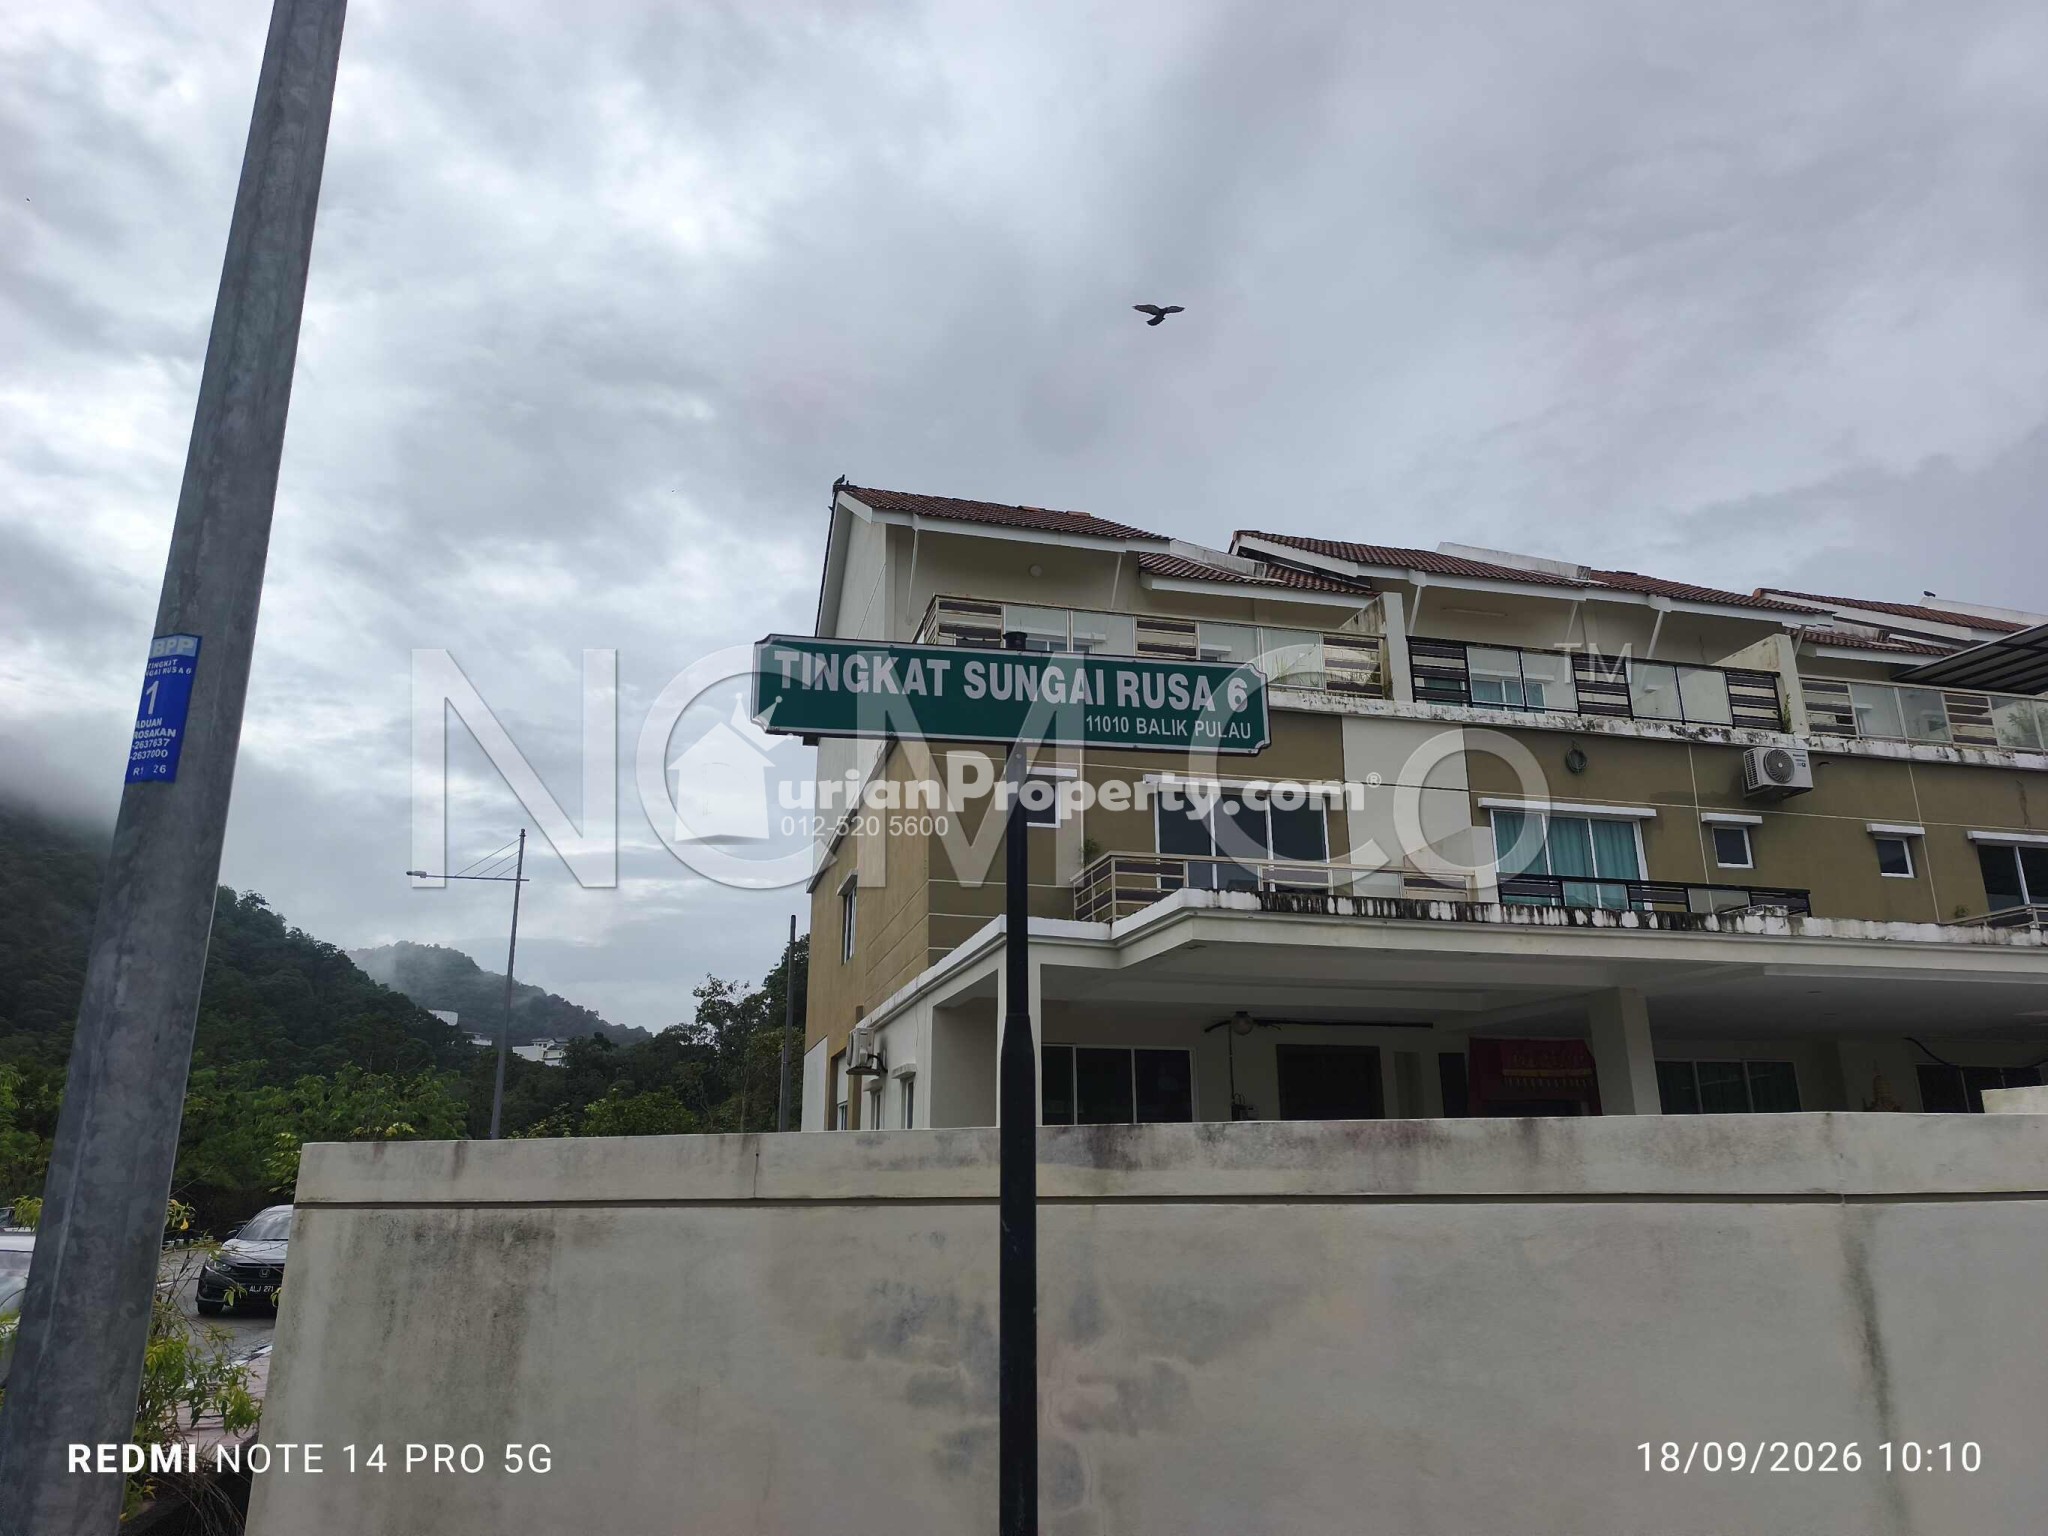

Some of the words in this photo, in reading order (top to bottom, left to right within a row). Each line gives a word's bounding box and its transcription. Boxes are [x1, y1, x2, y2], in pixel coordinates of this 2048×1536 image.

[146, 680, 159, 715] 1
[774, 650, 950, 698] TINGKAT
[964, 660, 1104, 706] SUNGAI
[1117, 671, 1217, 712] RUSA
[1228, 677, 1248, 711] 6
[1085, 715, 1130, 735] 11010
[1136, 717, 1187, 738] BALIK
[1194, 719, 1252, 740] PULAU
